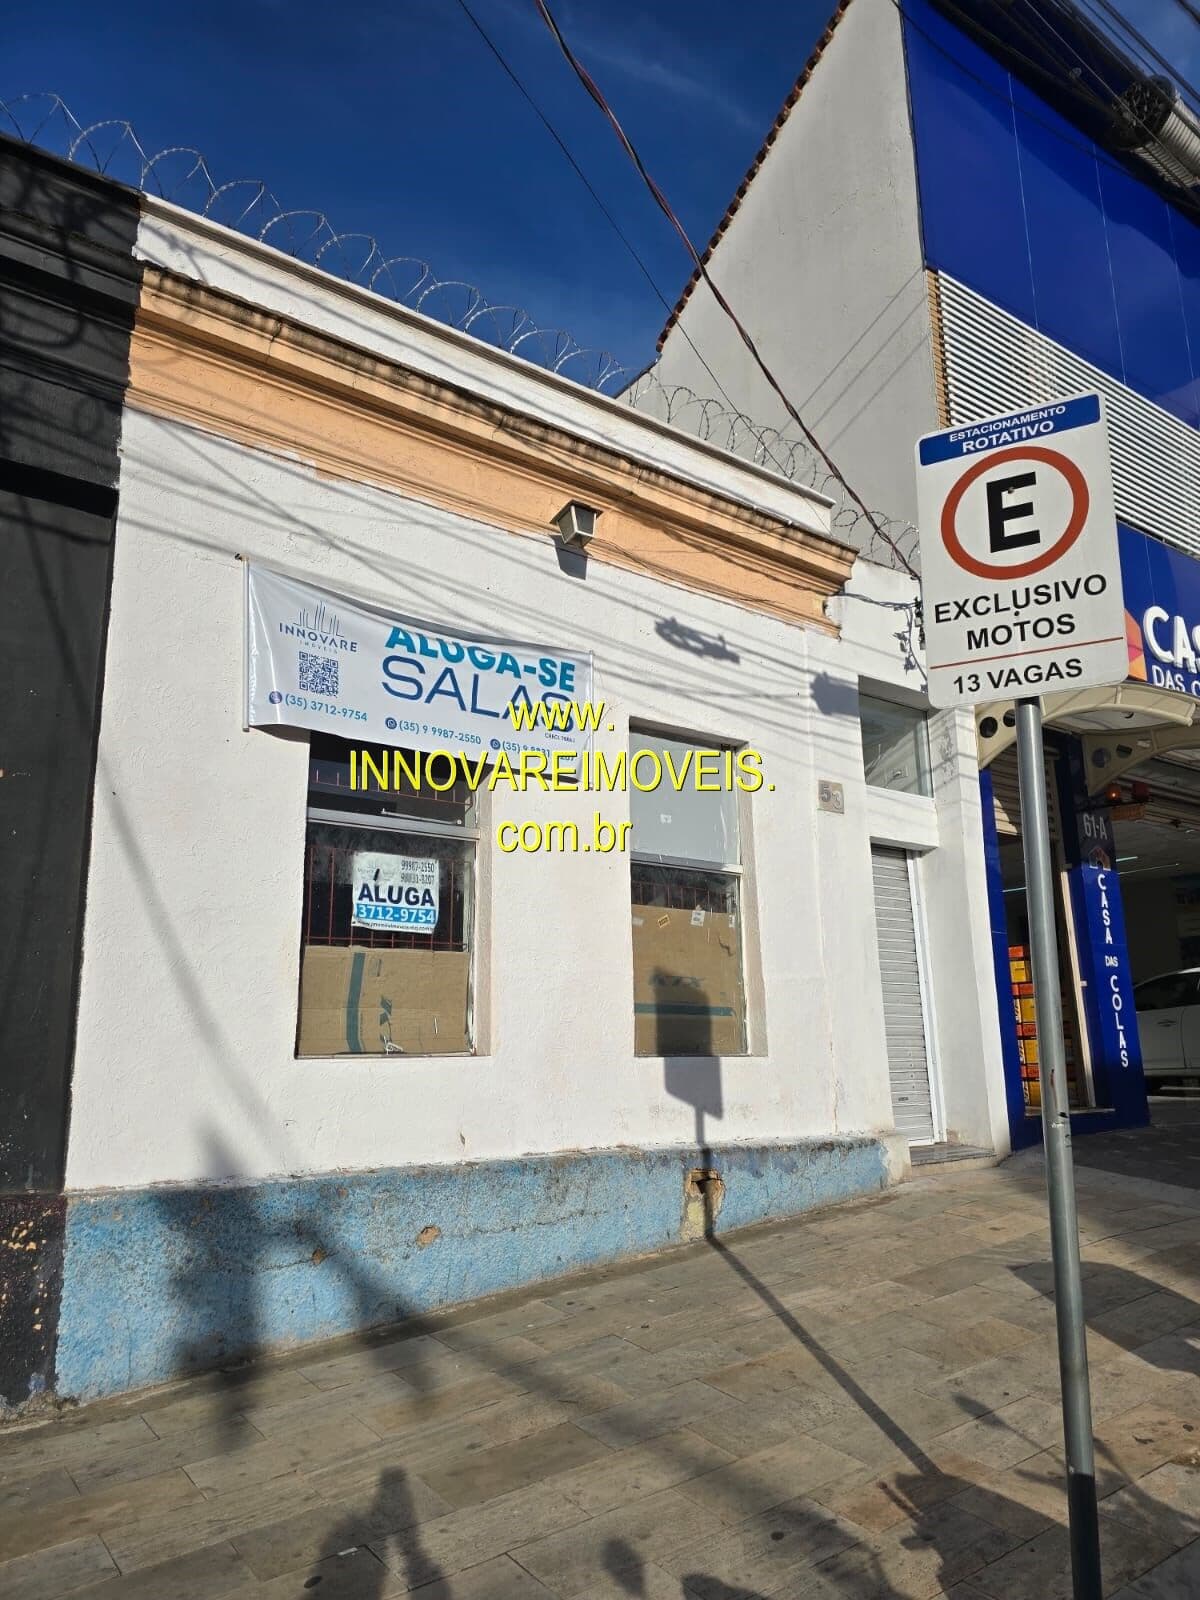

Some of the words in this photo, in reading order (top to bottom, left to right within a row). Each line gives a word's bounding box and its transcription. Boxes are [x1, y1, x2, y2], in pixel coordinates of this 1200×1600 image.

[949, 404, 1067, 443] ESTACIONAMENTO
[962, 420, 1055, 453] ROTATIVO
[986, 471, 1041, 554] E
[934, 574, 1107, 624] EXCLUSIVO
[279, 622, 358, 653] INNOVARE
[966, 613, 1076, 650] MOTOS
[385, 626, 576, 692] ALUGA-SE
[953, 674, 981, 694] 13
[987, 658, 1084, 688] VAGAS
[381, 655, 575, 733] SALAS
[1152, 664, 1186, 693] DAS
[285, 691, 308, 707] (35)
[310, 700, 368, 722] 3712-9754
[399, 719, 420, 735] (35)
[422, 725, 430, 735] 9
[431, 726, 482, 745] 9987-2550
[502, 740, 521, 753] (35)
[358, 883, 435, 907] ALUGA
[1096, 873, 1114, 945] CASA
[358, 904, 435, 923] 3712-9754
[1104, 954, 1119, 969] DAS
[1109, 974, 1129, 1068] COLAS
